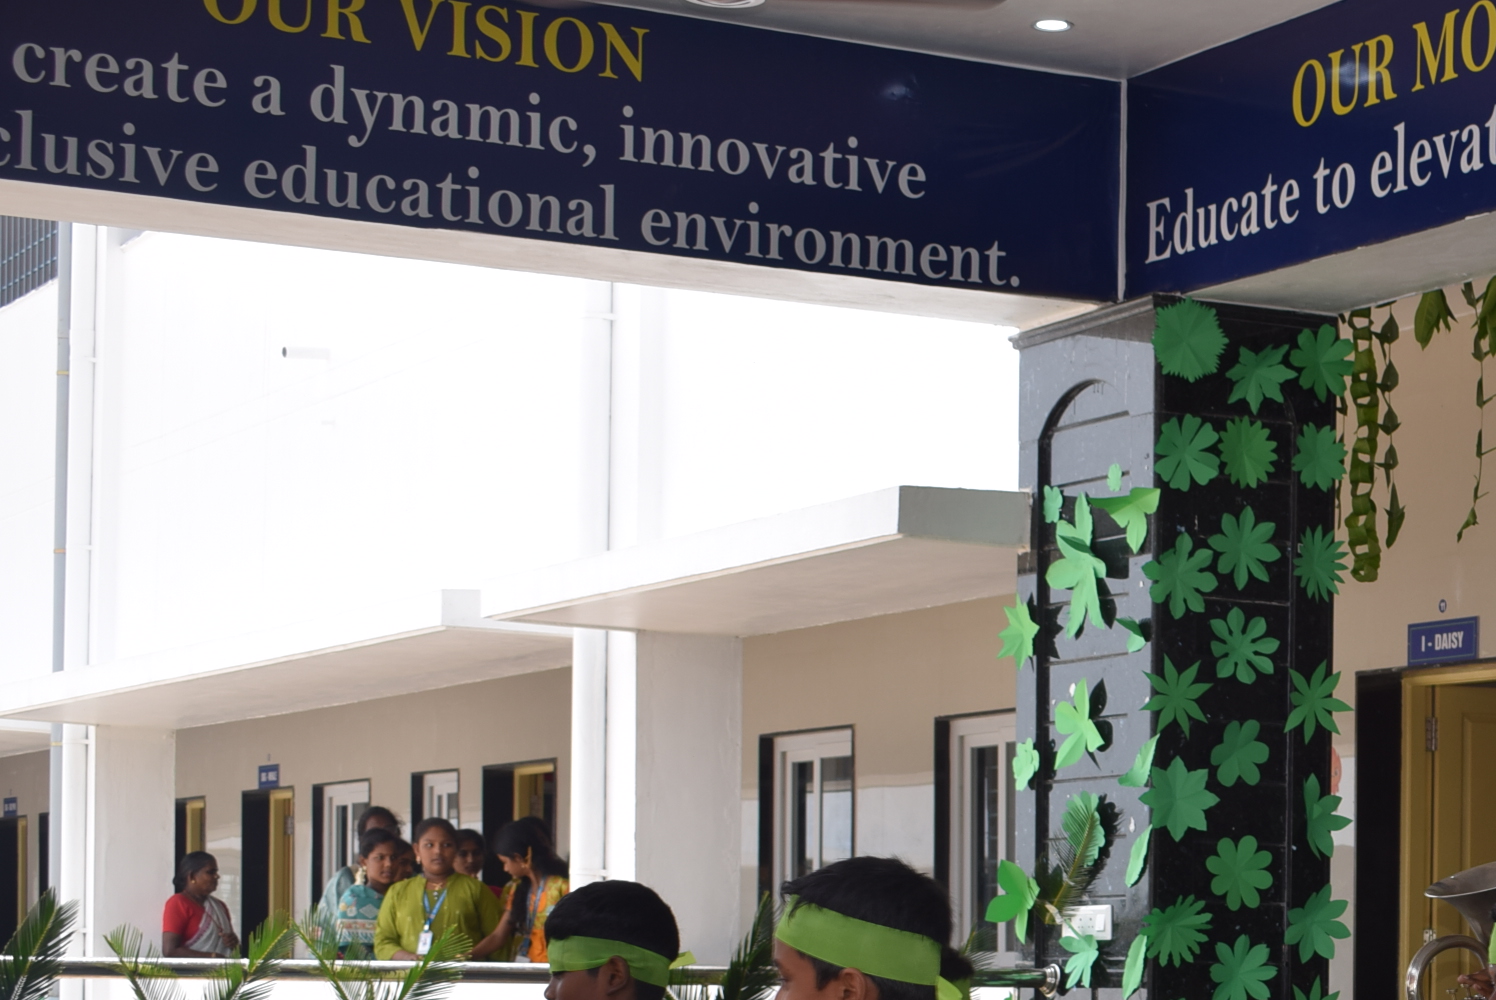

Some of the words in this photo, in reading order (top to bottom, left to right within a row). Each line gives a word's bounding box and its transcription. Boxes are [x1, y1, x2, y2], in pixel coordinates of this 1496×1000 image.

[401, 0, 649, 82] VISION
[1292, 35, 1397, 127] OUR
[13, 43, 228, 108] create
[252, 76, 286, 116] a
[310, 65, 597, 168] dynamic,
[620, 106, 926, 199] innovative
[244, 145, 619, 241] educational
[641, 202, 1020, 287] environment.
[1146, 174, 1300, 264] Educate
[1313, 158, 1356, 214] to
[1434, 631, 1464, 651] DAISY
